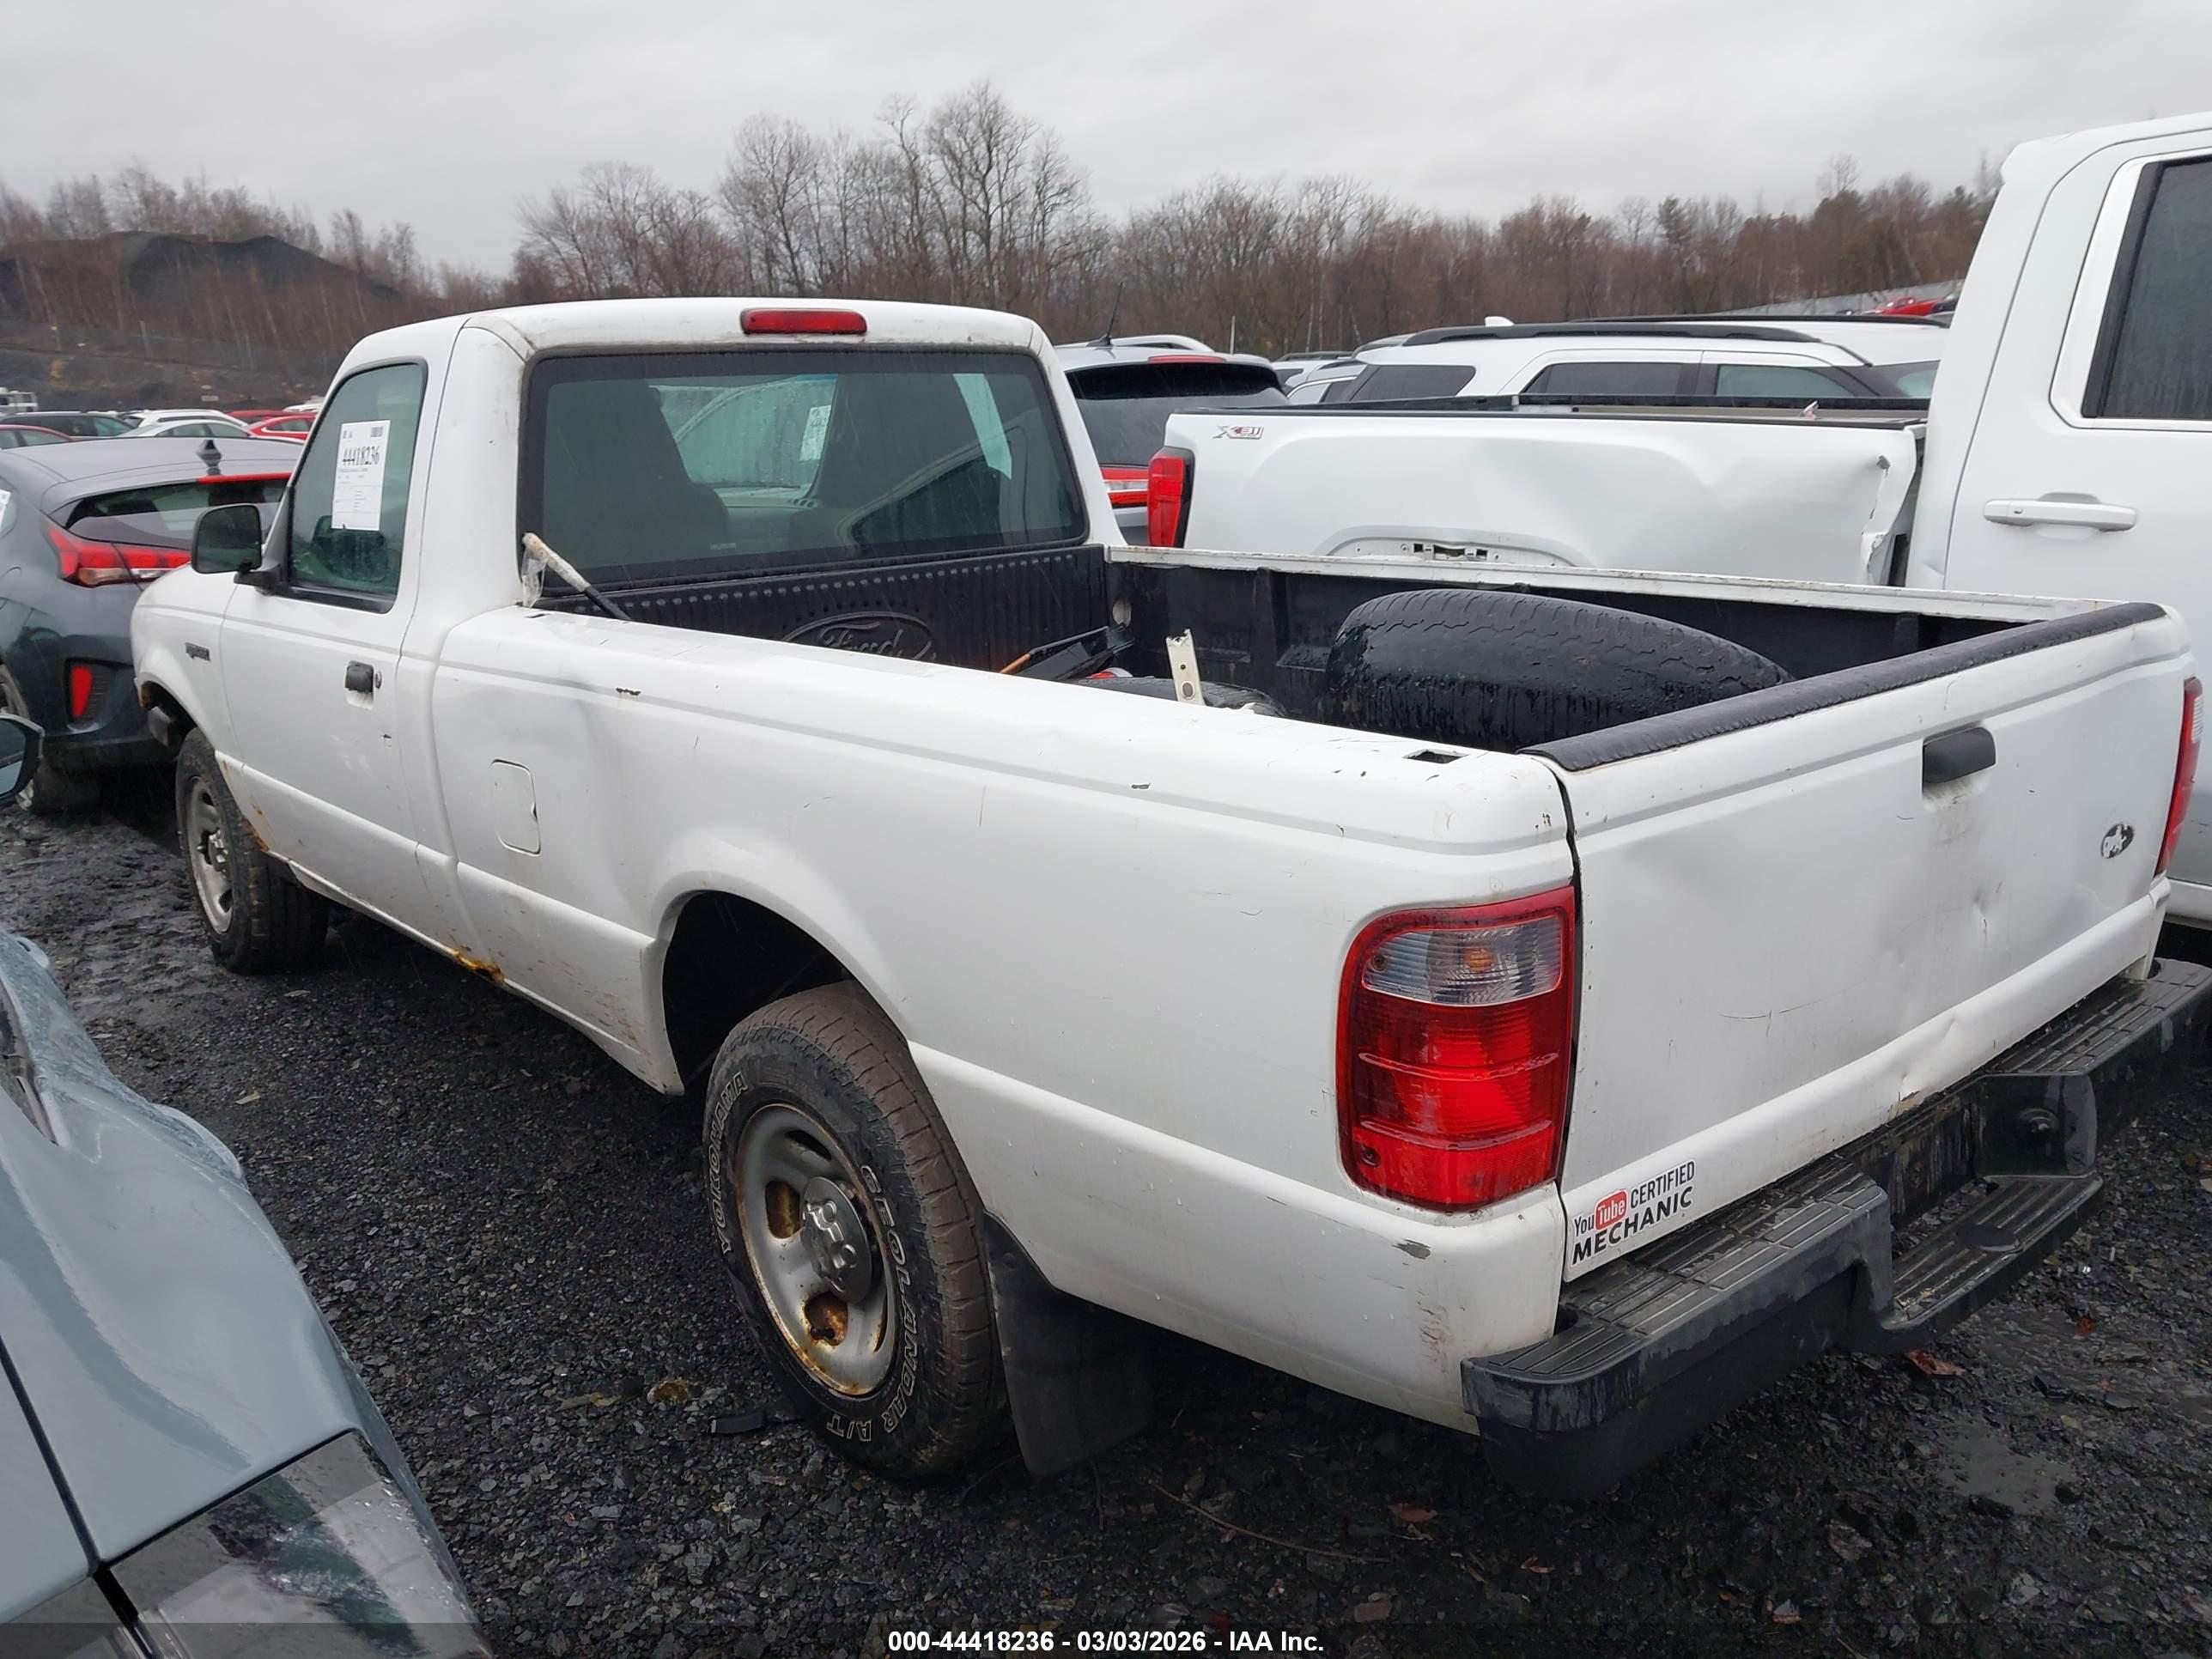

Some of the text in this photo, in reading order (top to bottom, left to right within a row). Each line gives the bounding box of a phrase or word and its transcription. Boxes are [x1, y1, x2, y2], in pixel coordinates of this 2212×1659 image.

[708, 1072, 749, 1255] YOKOHAMA
[1631, 1161, 1695, 1209] CERTIFIED
[1572, 1186, 1693, 1266] MECHANIC
[827, 1413, 872, 1442] A/T
